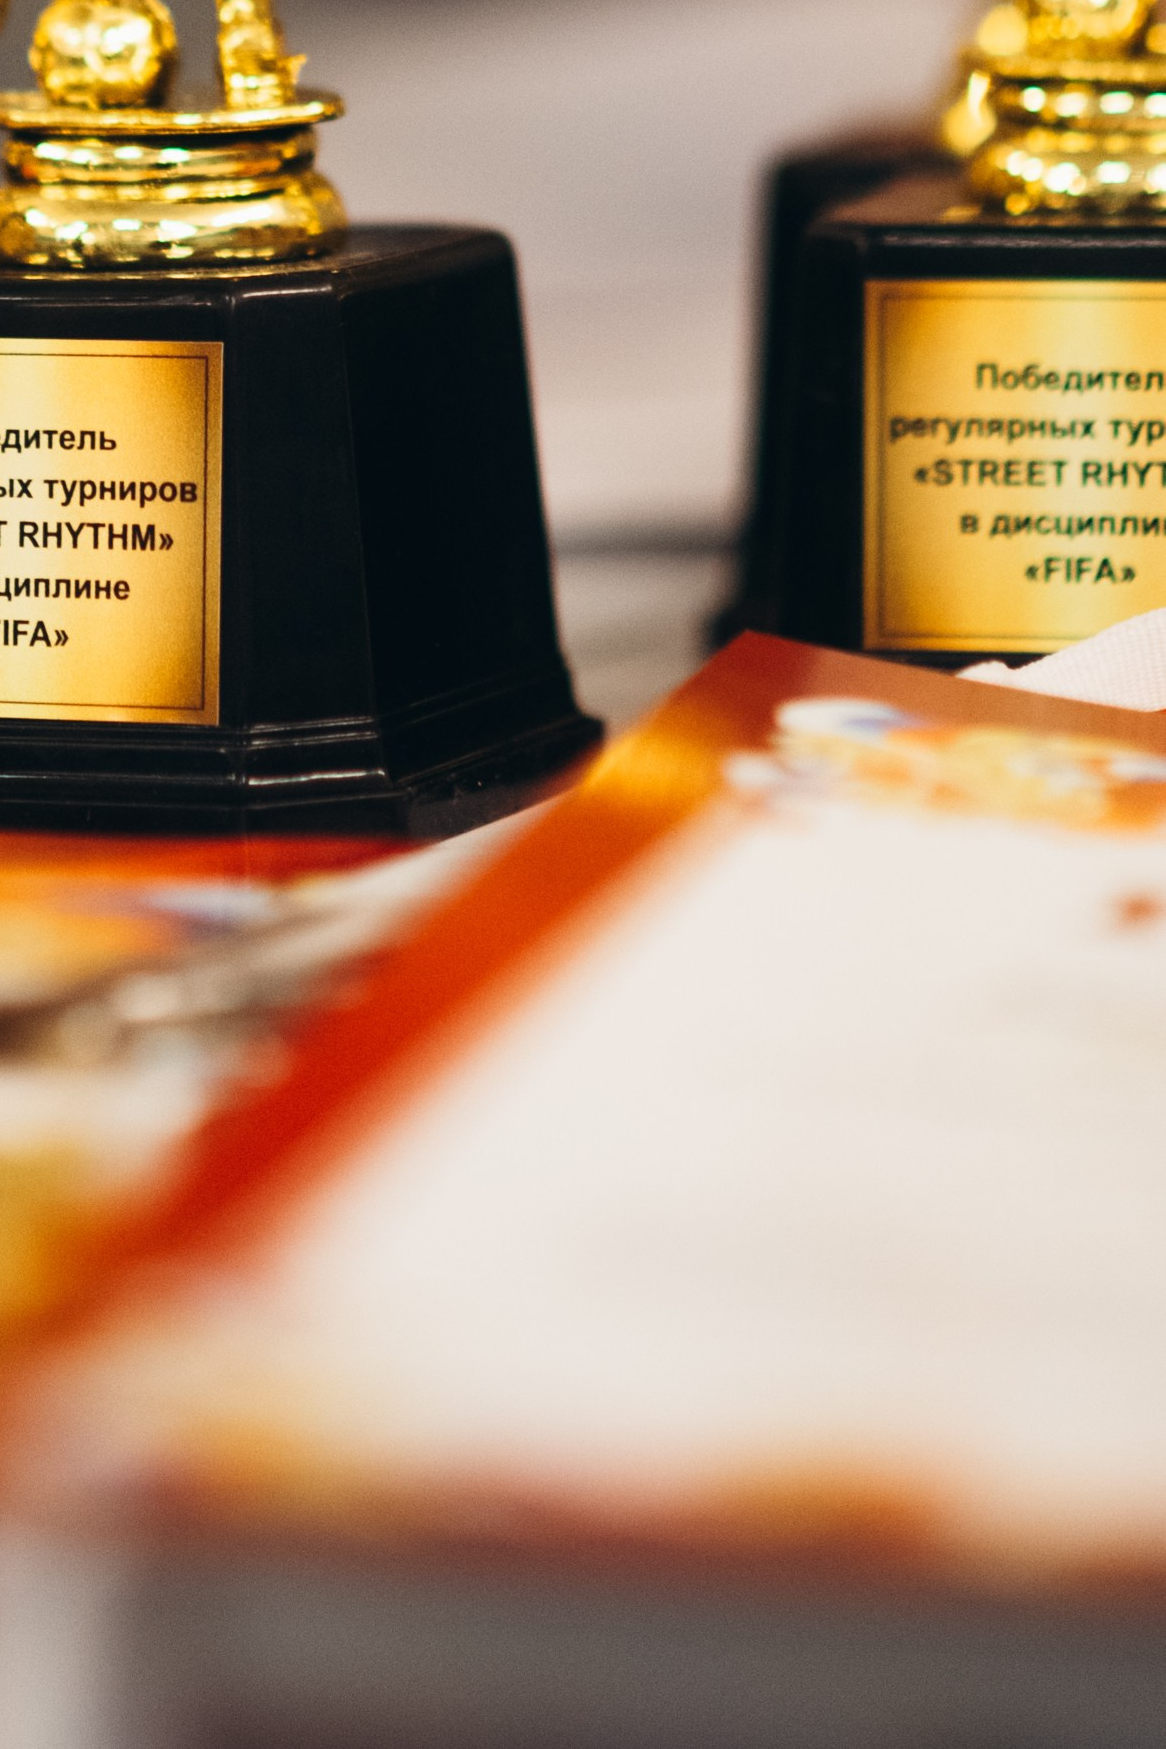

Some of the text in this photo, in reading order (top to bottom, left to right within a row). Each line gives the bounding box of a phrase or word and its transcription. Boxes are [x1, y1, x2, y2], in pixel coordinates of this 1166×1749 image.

[888, 416, 1095, 444] регулярных
[914, 458, 1068, 486] «STREET
[44, 479, 197, 508] турниров
[19, 521, 173, 551] RHYTHM»
[960, 514, 1166, 538] в дисципли
[1025, 556, 1136, 583] «FIFA»
